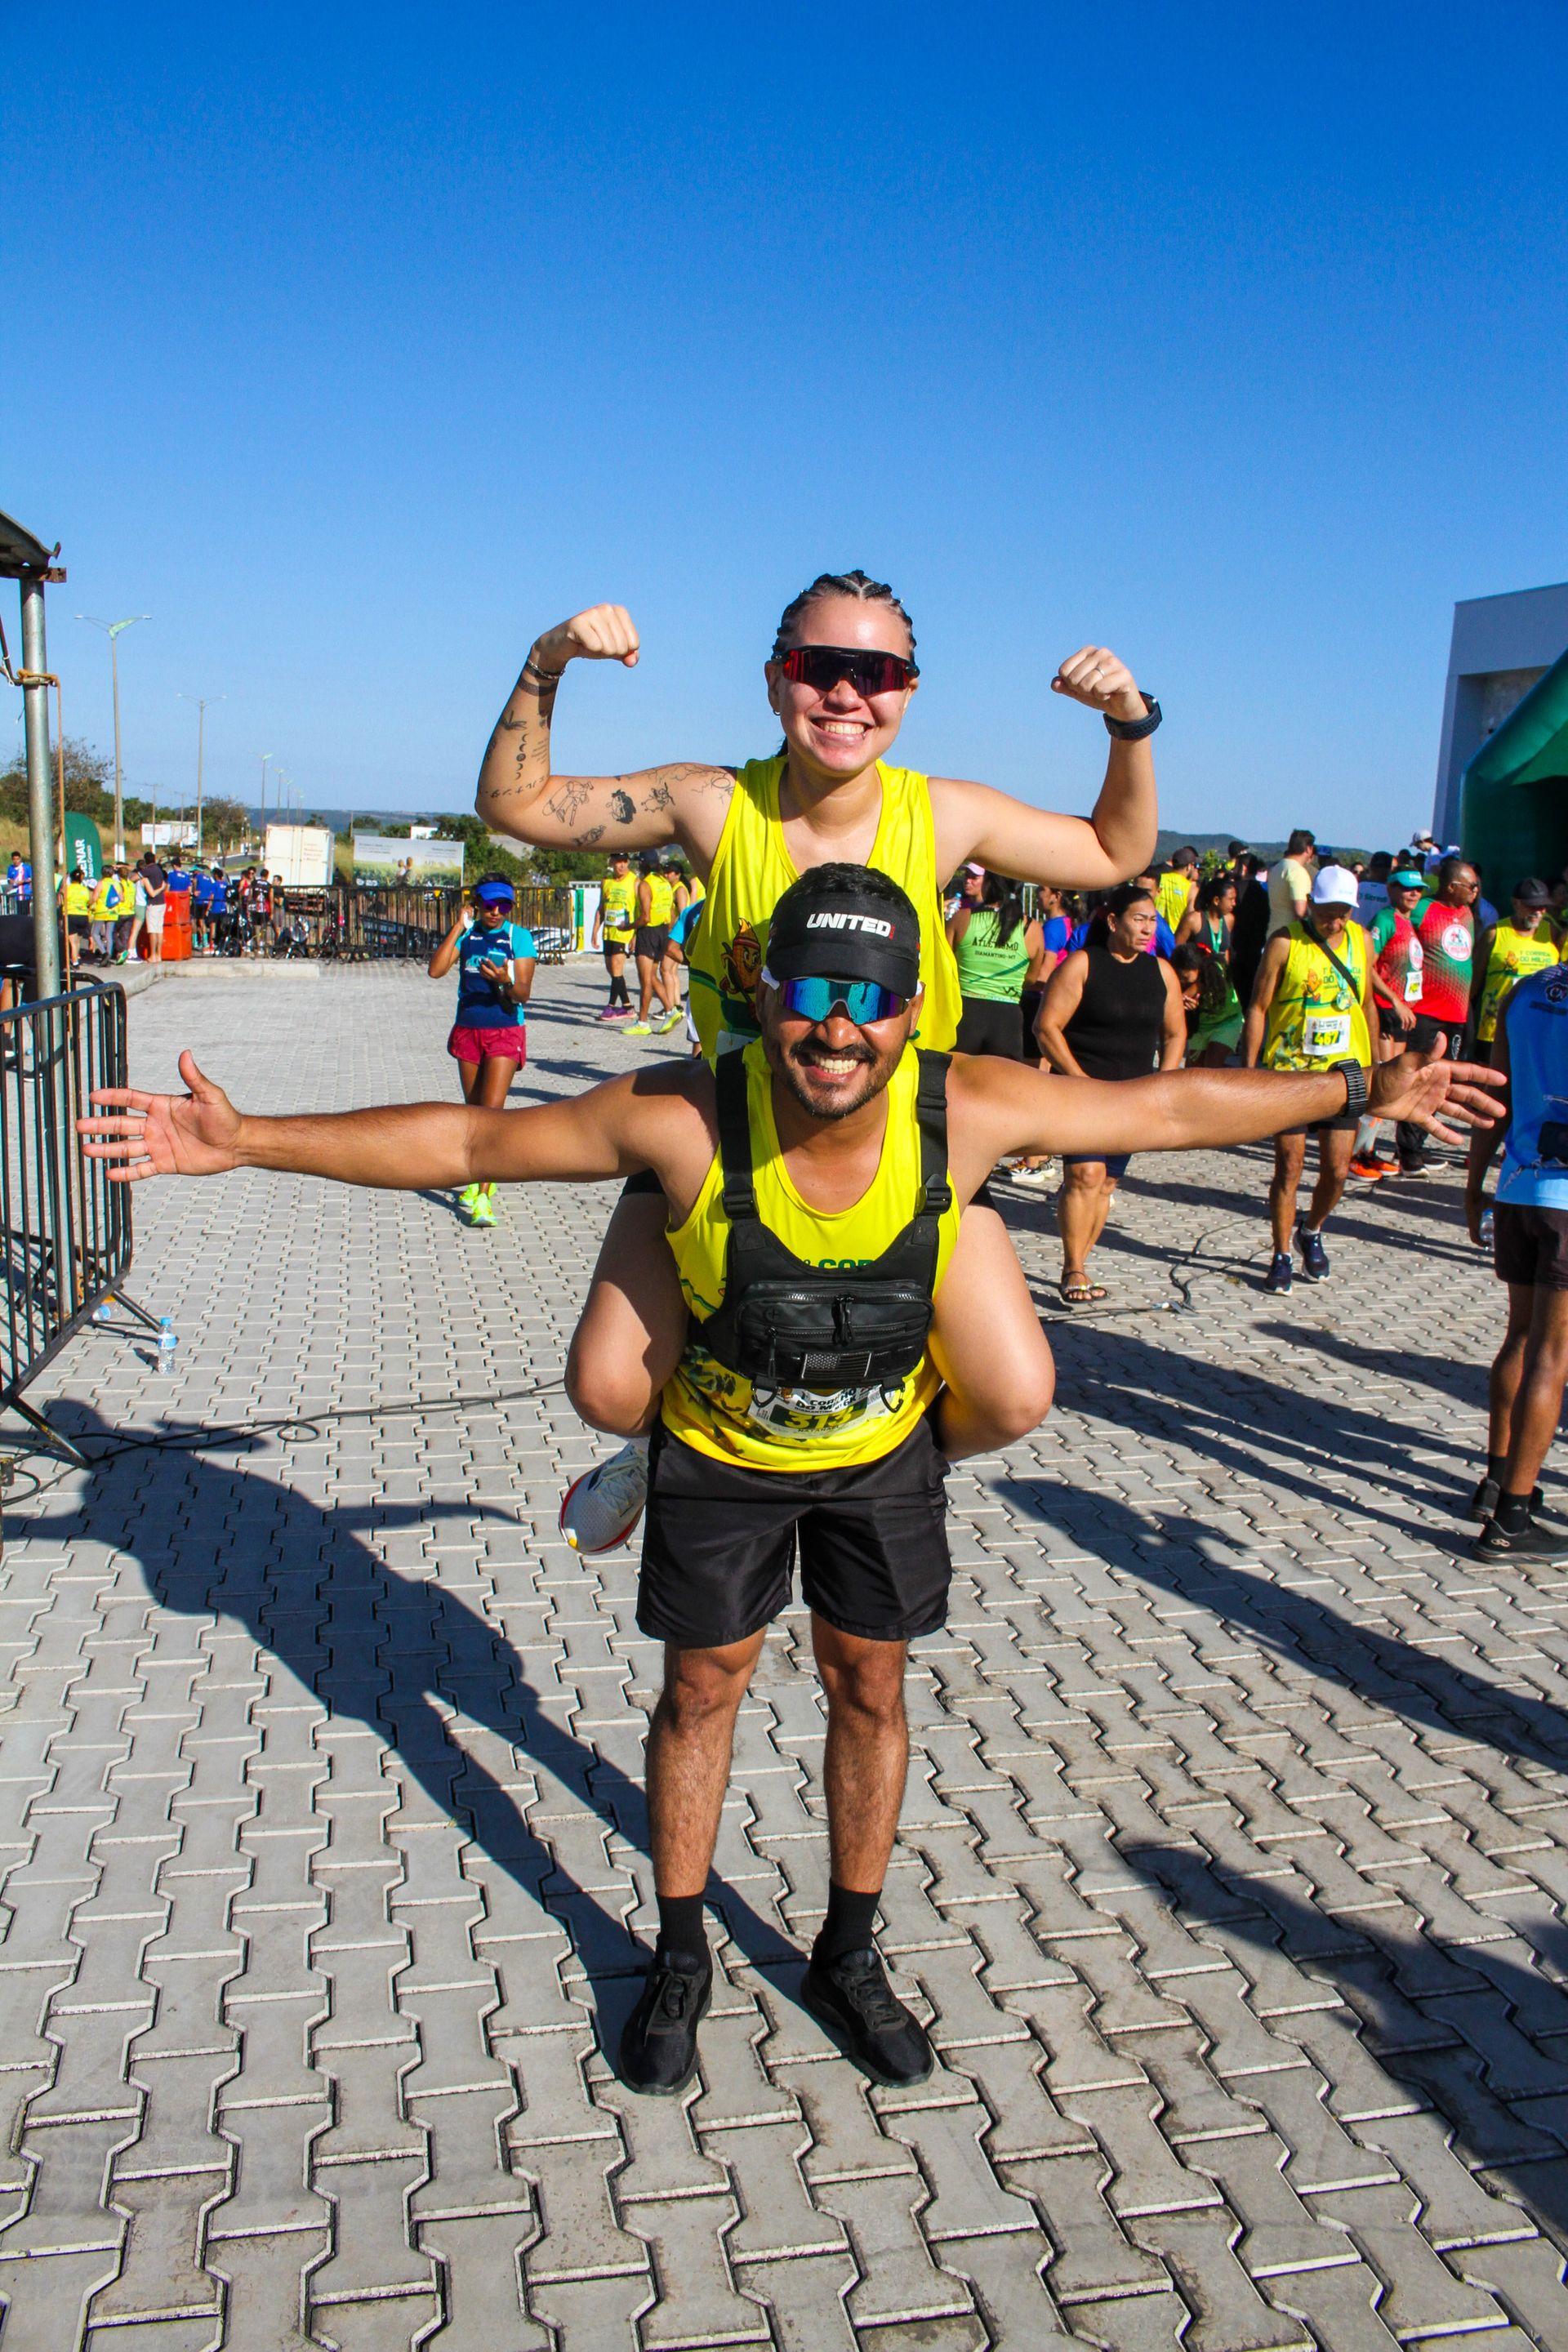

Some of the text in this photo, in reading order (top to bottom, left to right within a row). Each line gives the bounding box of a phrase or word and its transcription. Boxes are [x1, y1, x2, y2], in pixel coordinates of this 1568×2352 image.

[806, 913, 892, 938] UNITED
[972, 936, 1019, 951] ATLETMO
[1314, 1031, 1339, 1046] 467
[784, 1405, 854, 1430] 313
